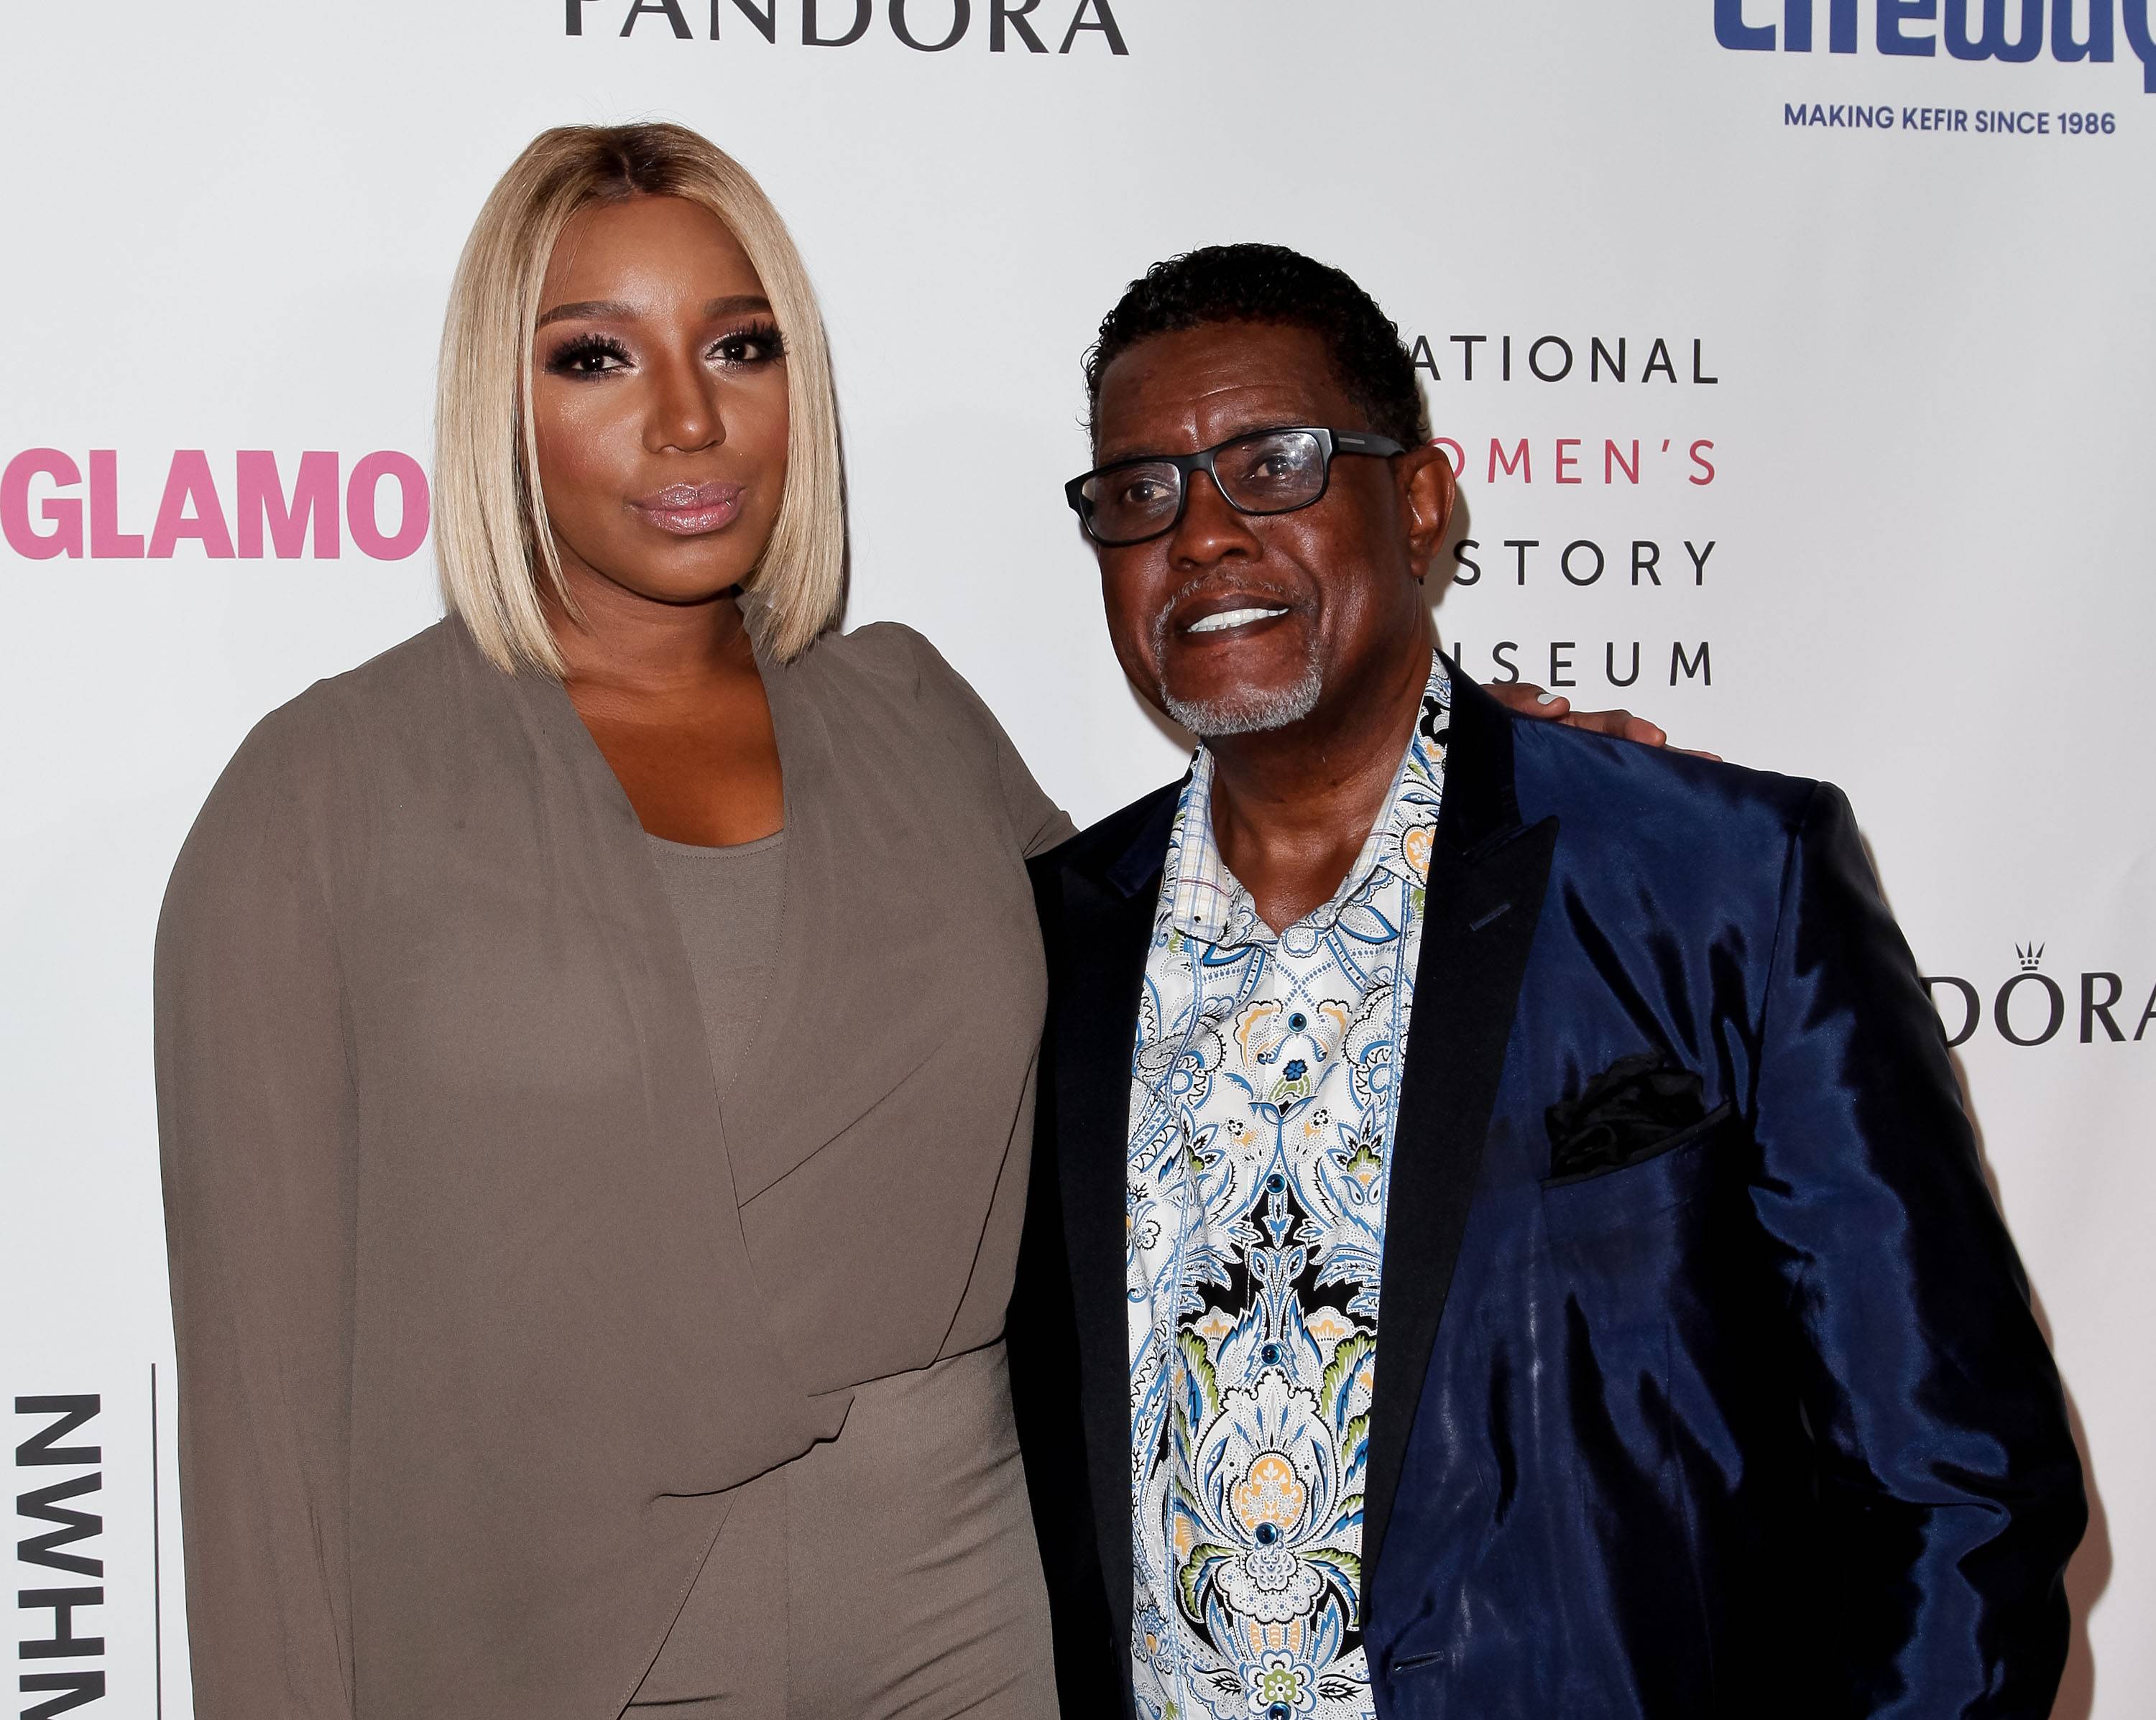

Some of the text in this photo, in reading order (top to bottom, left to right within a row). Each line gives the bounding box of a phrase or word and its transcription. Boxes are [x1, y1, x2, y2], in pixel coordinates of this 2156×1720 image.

[1784, 103, 2116, 134] MAKING KEFIR SINCE 1986
[0, 448, 430, 560] GLAMO
[1419, 539, 1716, 586] STORY
[1454, 642, 1712, 686] SEUM
